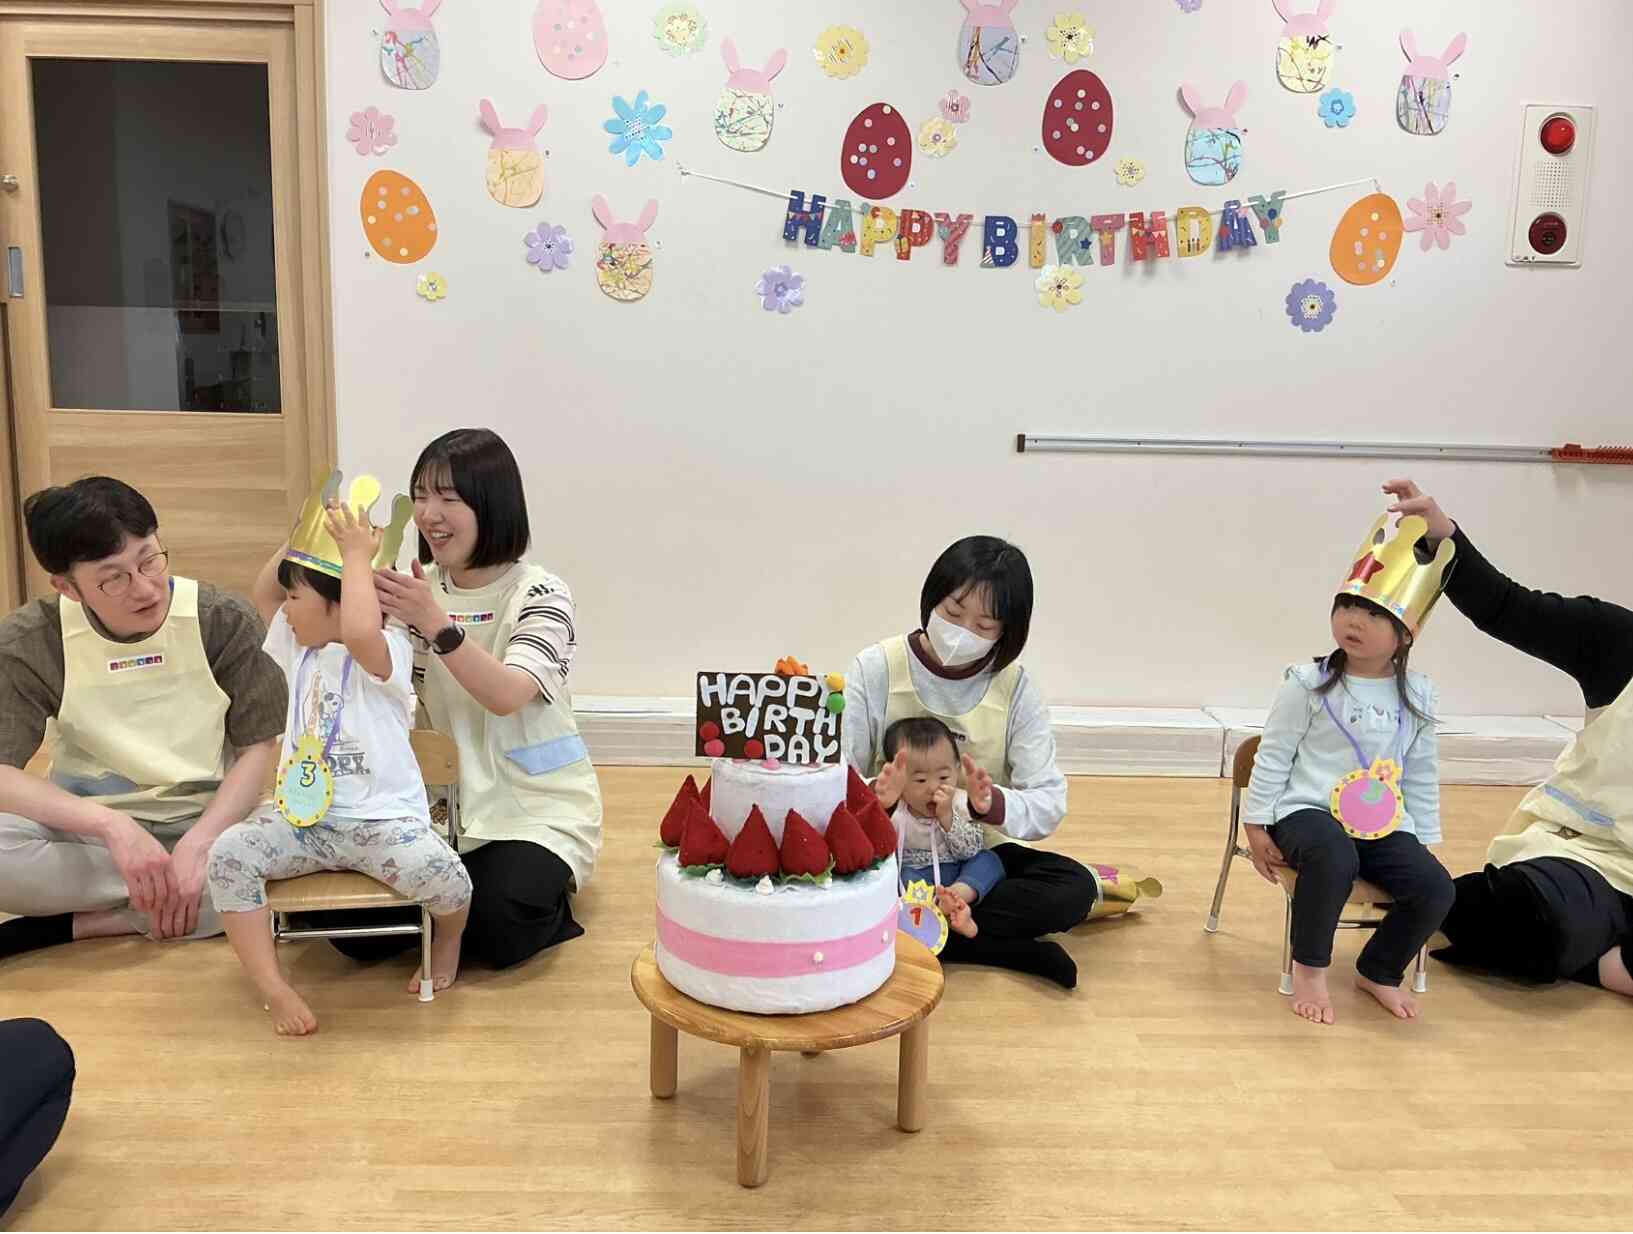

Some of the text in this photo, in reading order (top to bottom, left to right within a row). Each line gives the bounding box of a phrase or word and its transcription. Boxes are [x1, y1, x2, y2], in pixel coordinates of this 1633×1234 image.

[783, 190, 1286, 268] HAPPY BIRTHDAY
[721, 704, 837, 737] BIRTH
[764, 734, 838, 764] DAY
[300, 761, 316, 787] 3
[910, 905, 923, 928] 1
